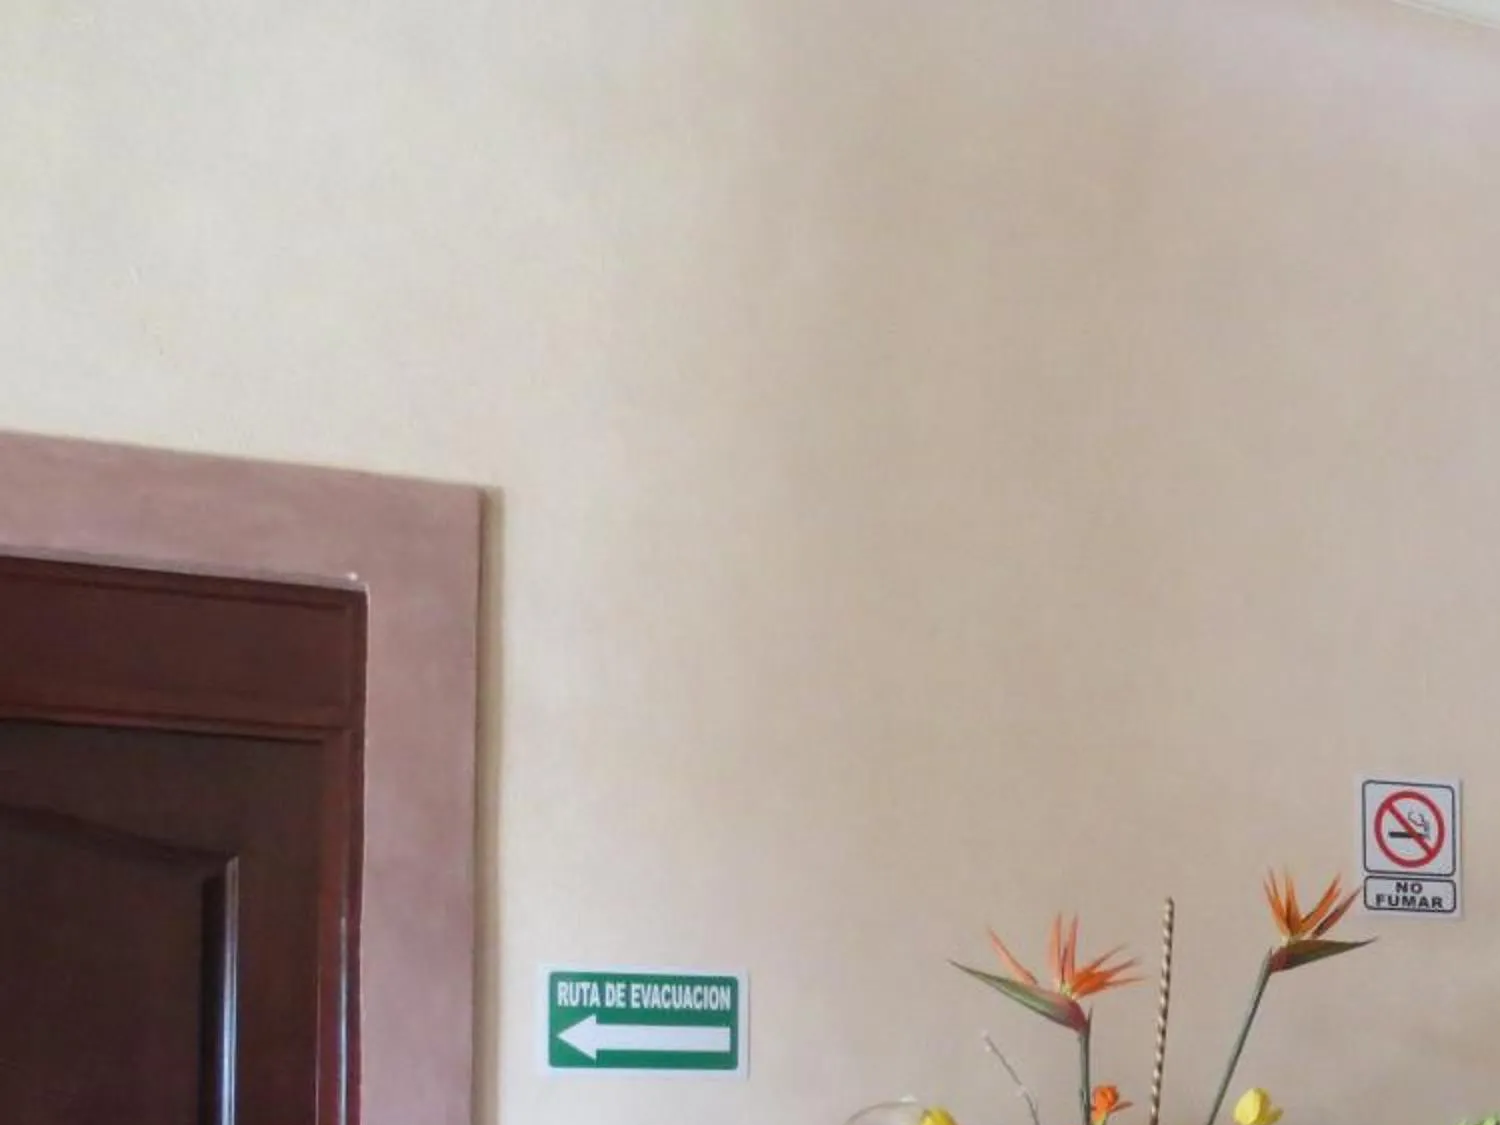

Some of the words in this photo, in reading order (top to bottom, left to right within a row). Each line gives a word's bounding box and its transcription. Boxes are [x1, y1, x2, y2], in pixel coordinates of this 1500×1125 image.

[1395, 881, 1423, 894] NO
[1375, 894, 1443, 908] FUMAR
[557, 981, 601, 1007] RUTA
[605, 982, 627, 1009] DE
[631, 983, 731, 1011] EVACUACION
